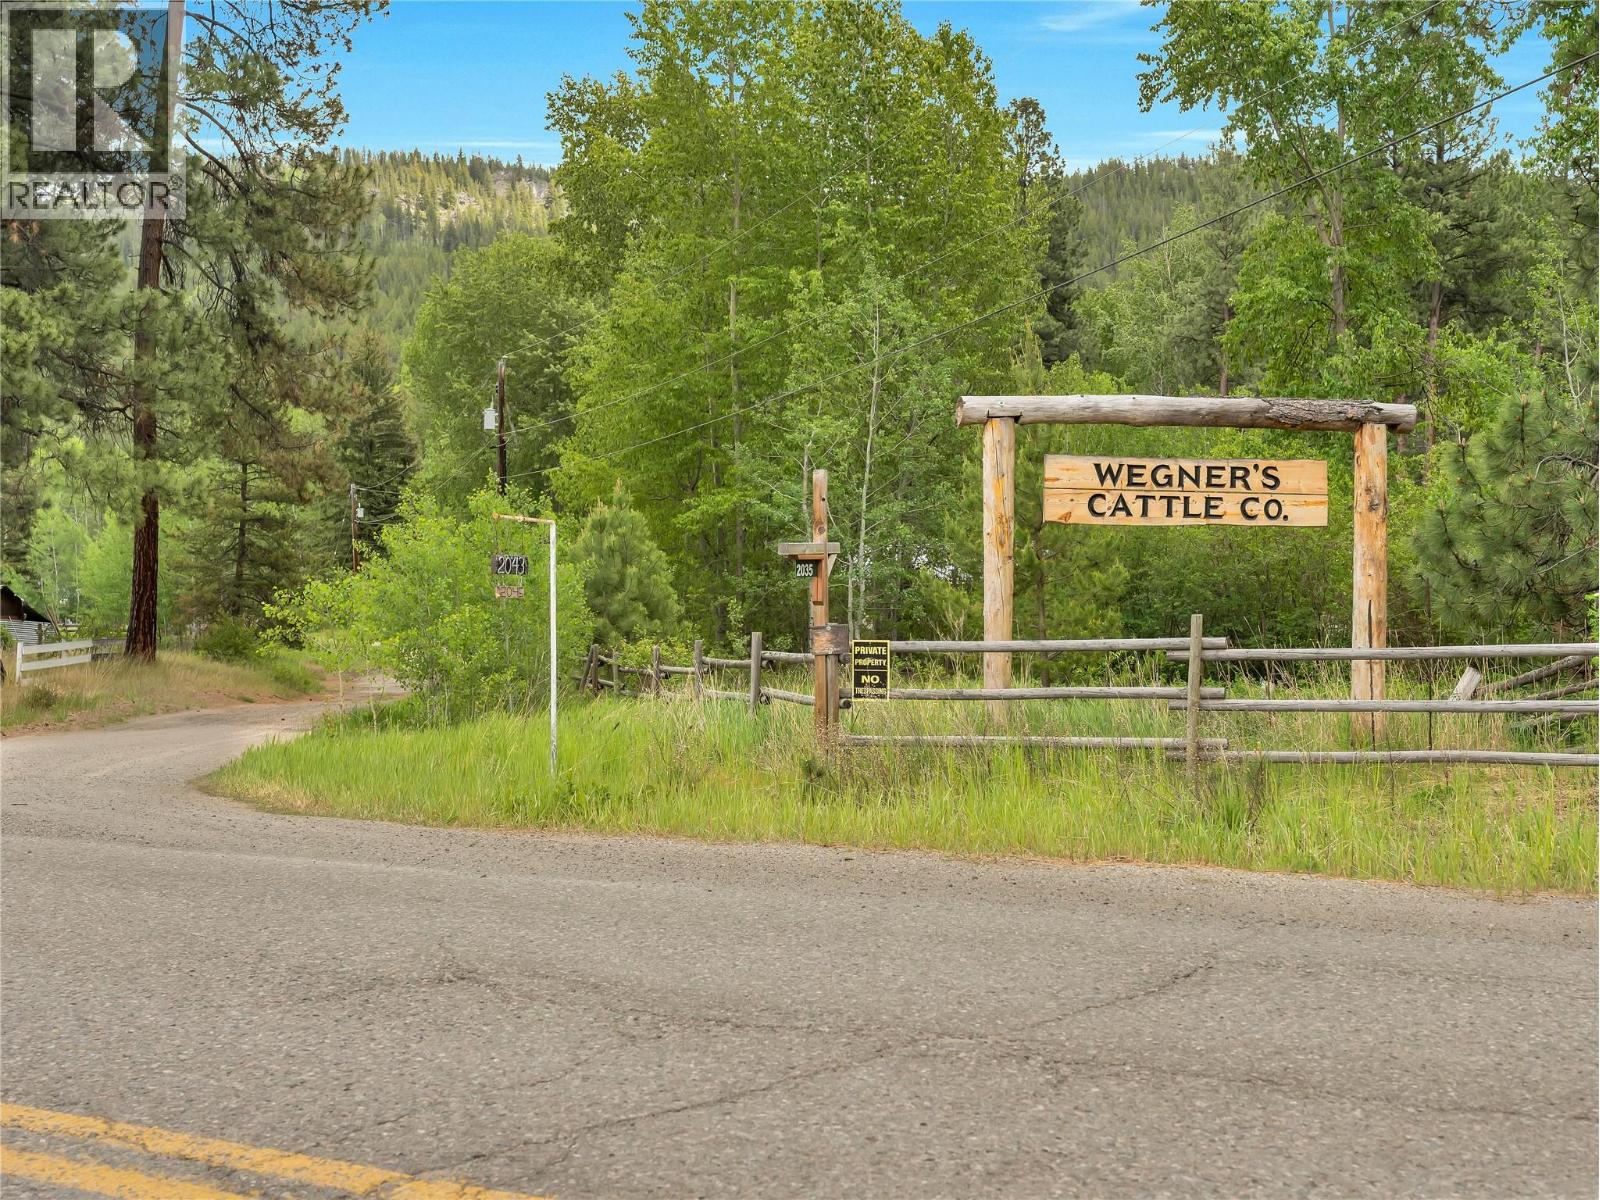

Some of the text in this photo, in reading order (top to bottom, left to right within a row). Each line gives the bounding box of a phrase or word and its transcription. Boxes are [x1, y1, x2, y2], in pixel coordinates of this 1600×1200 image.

[1093, 463, 1281, 491] WEGNER'S
[1087, 494, 1289, 521] CATTLE CO.
[497, 556, 525, 575] 2043
[796, 563, 814, 577] 2035
[854, 646, 887, 655] PRIVATE
[854, 658, 887, 666] PROPERTY
[861, 675, 880, 684] NO
